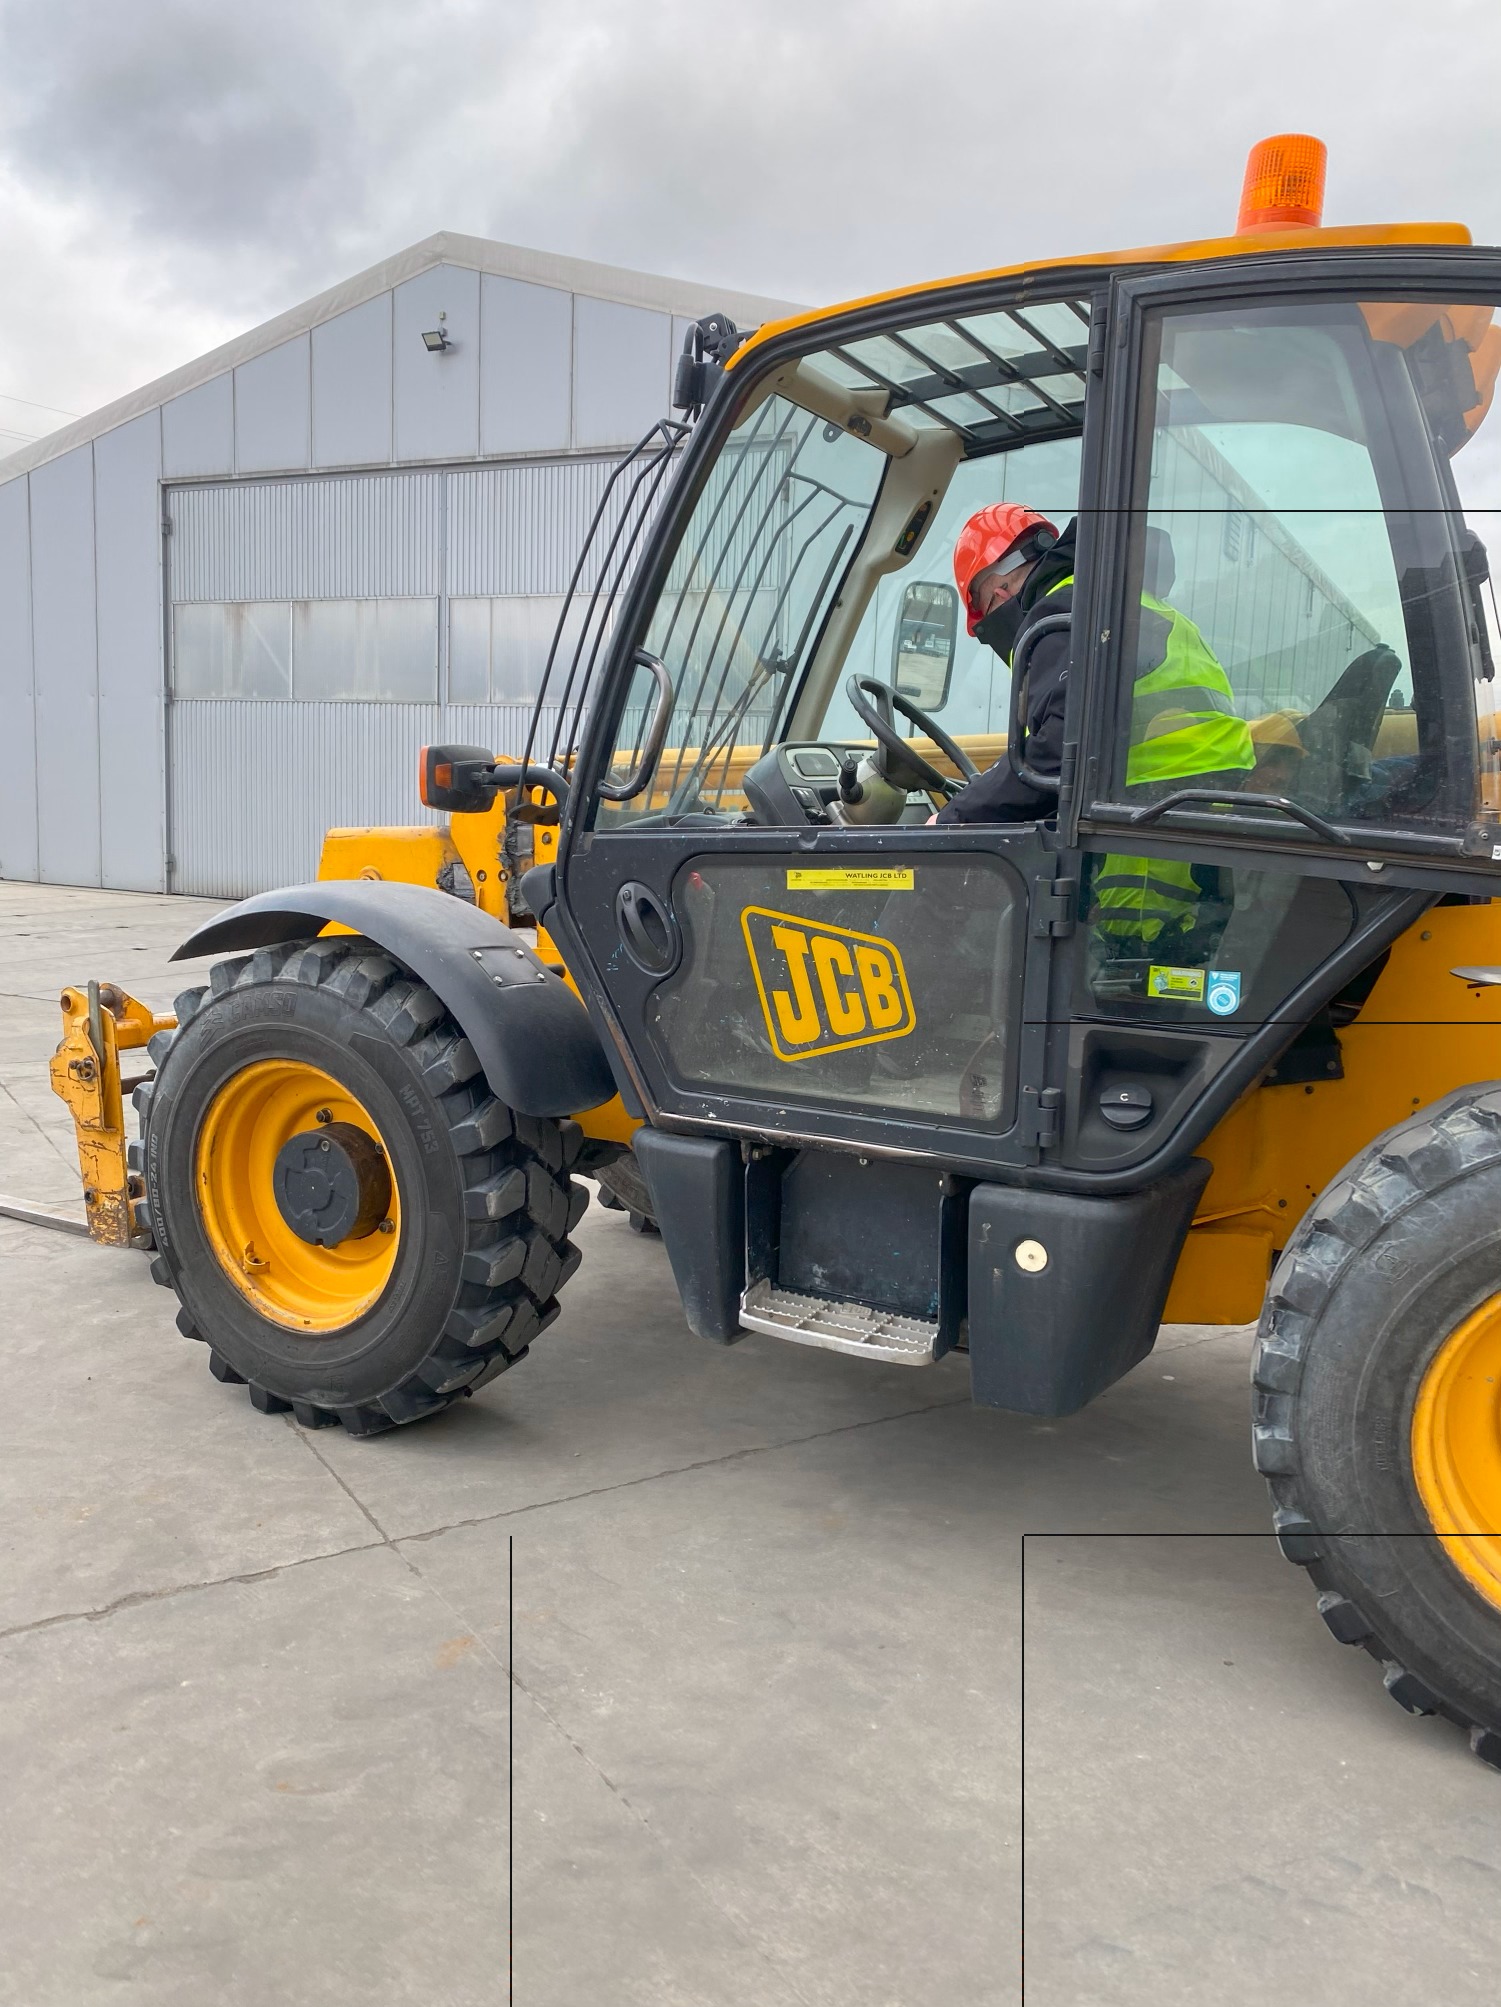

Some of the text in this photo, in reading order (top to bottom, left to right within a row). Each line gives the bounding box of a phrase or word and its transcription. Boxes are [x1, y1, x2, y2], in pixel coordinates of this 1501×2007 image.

[771, 925, 902, 1045] JCB
[400, 1083, 440, 1155] MPT 753
[1120, 1093, 1129, 1102] C
[150, 1133, 158, 1158] IND
